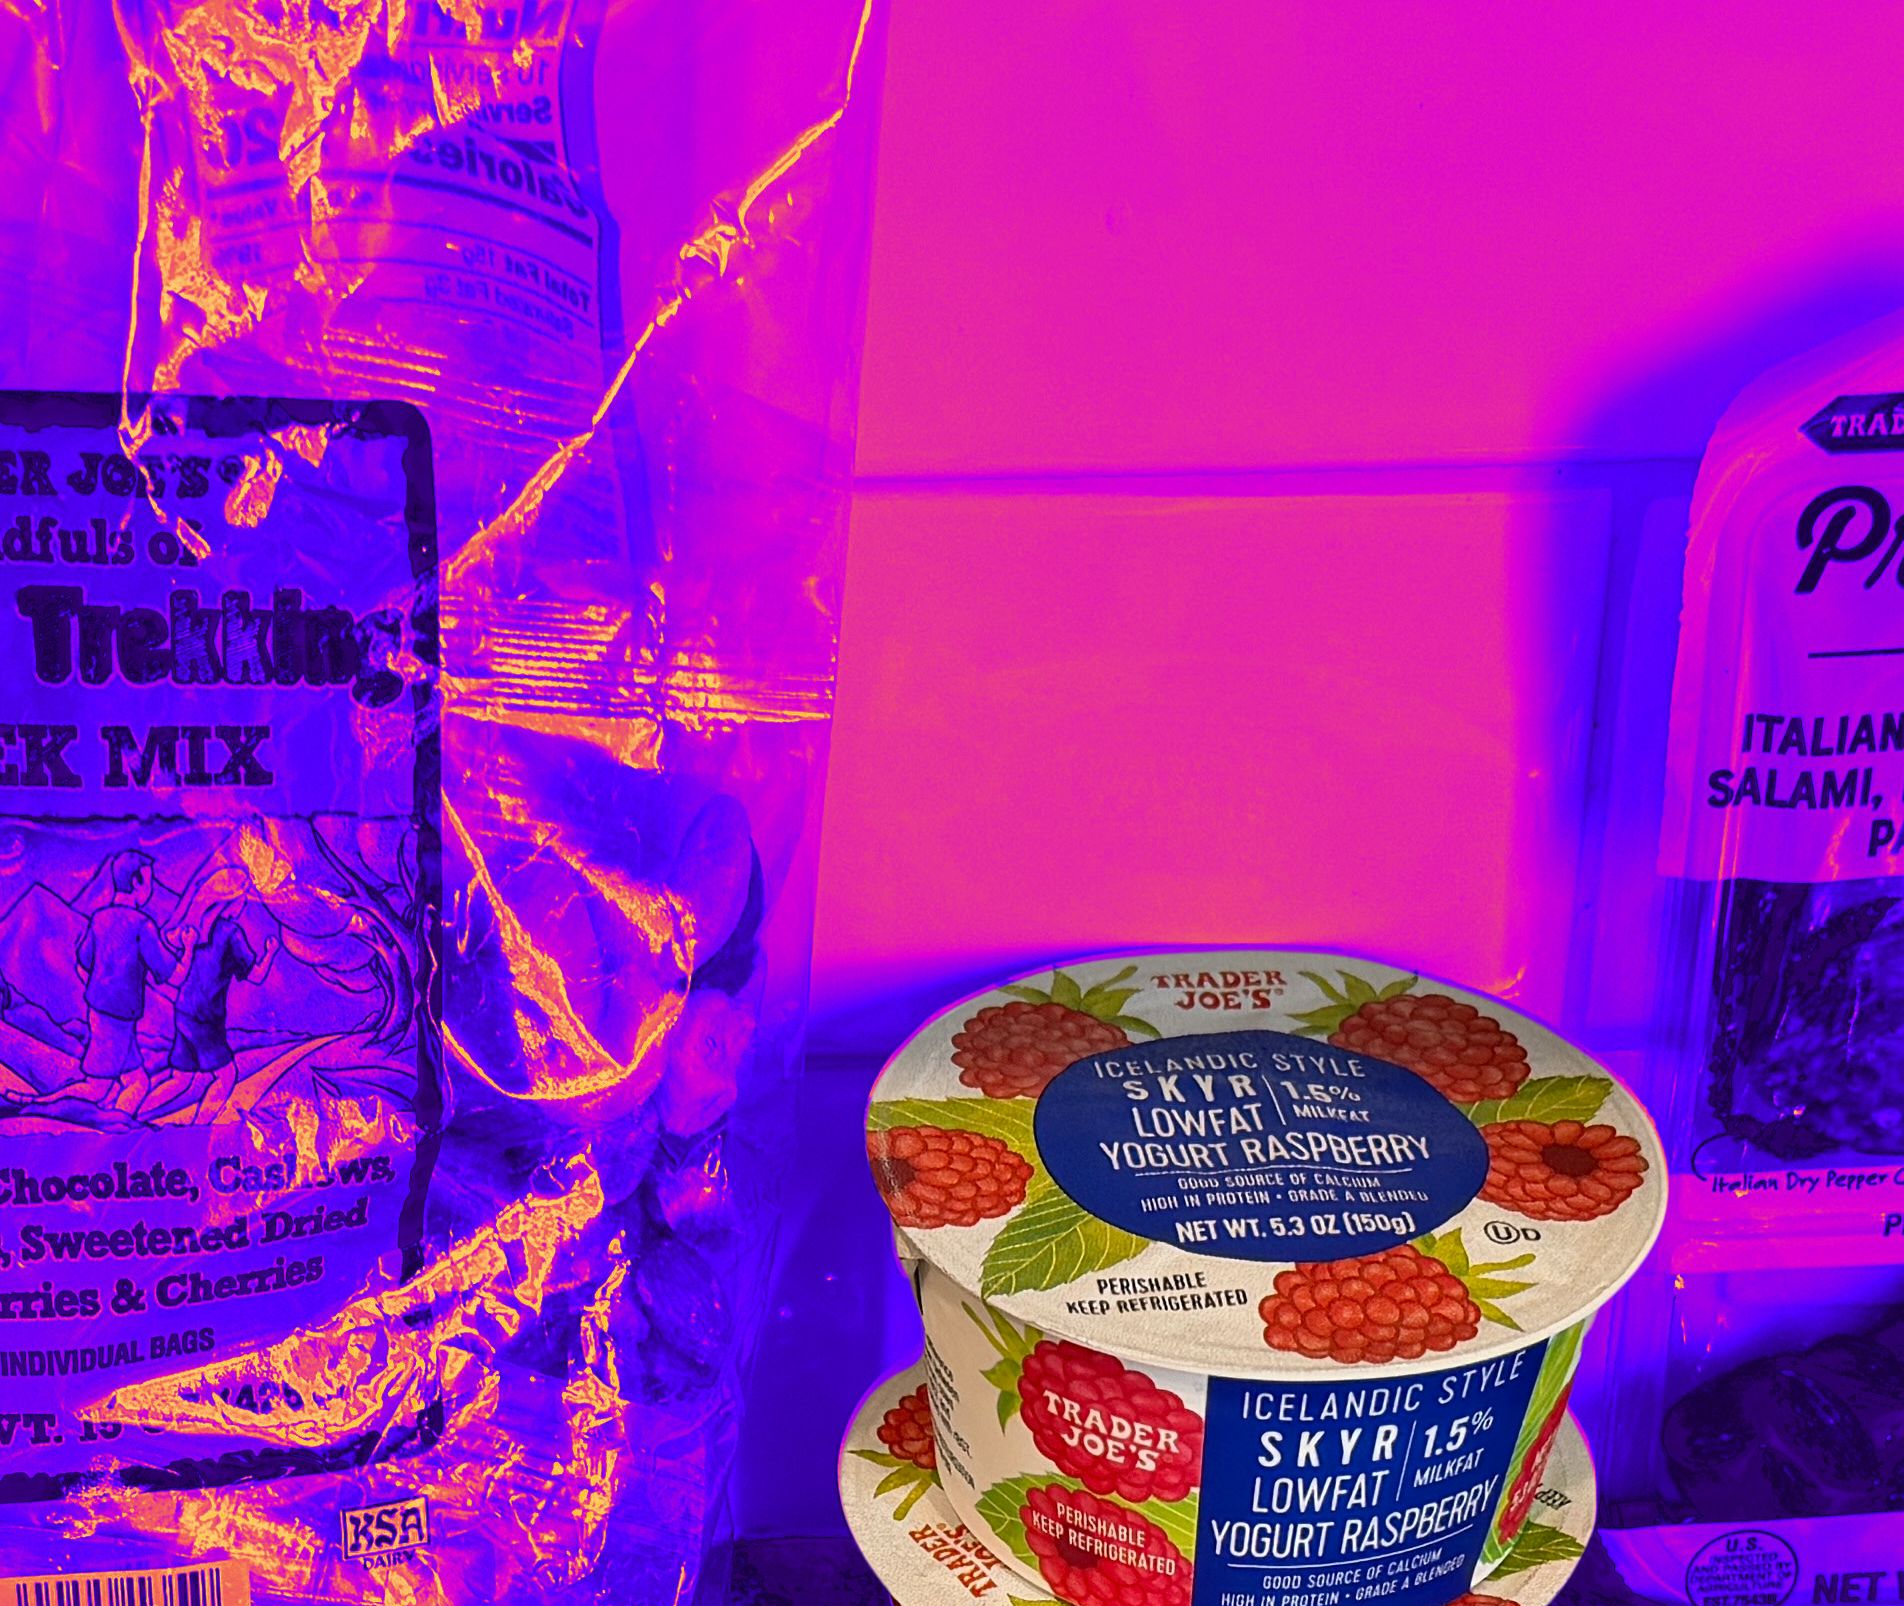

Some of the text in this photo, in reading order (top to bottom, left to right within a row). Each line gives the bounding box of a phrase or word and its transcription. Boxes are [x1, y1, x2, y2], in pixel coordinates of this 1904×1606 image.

[16, 585, 407, 709] Trekking
[102, 723, 275, 787] MIX
[1706, 763, 1885, 812] SALAMI,
[1150, 970, 1287, 990] TRADER
[1094, 1053, 1366, 1079] ICELANDIC STYLE
[1131, 1103, 1264, 1138] LOWFAT
[1100, 1132, 1433, 1171] YOGURT RASPBERRY
[1206, 1191, 1271, 1206] PROTEIN
[1225, 1173, 1284, 1188] SOURCE
[1711, 1174, 1780, 1194] Italian
[1786, 1171, 1820, 1195] Dry
[1825, 1170, 1887, 1192] Pepper
[19, 1216, 250, 1261] Sweetened
[259, 1196, 368, 1244] Dried
[1175, 1211, 1416, 1243] NET WT. 5.3 OZ (150g)
[111, 1278, 146, 1314] &
[155, 1255, 324, 1308] Cherries
[1066, 1288, 1248, 1317] KEEP REFRIGERATED
[1096, 1271, 1209, 1295] PERISHABLE
[0, 1338, 146, 1378] INDIVIDUAL
[149, 1327, 216, 1363] BAGS
[1242, 1350, 1526, 1421] ICELANDIC STYLE
[1042, 1389, 1180, 1454] TRADER
[1061, 1426, 1160, 1472] JOE'S
[1413, 1448, 1485, 1488] MILKFAT
[1252, 1470, 1390, 1514] LOWFAT
[1056, 1502, 1146, 1548] PERISHABLE
[1211, 1473, 1500, 1559] YOGURT RASPBERRY
[1032, 1510, 1176, 1576] KEEP REFRIGERATED
[1263, 1547, 1443, 1590] GOOD SOURCE OF CALCIUM
[1812, 1571, 1887, 1604] NET
[1355, 1582, 1397, 1602] GRADE
